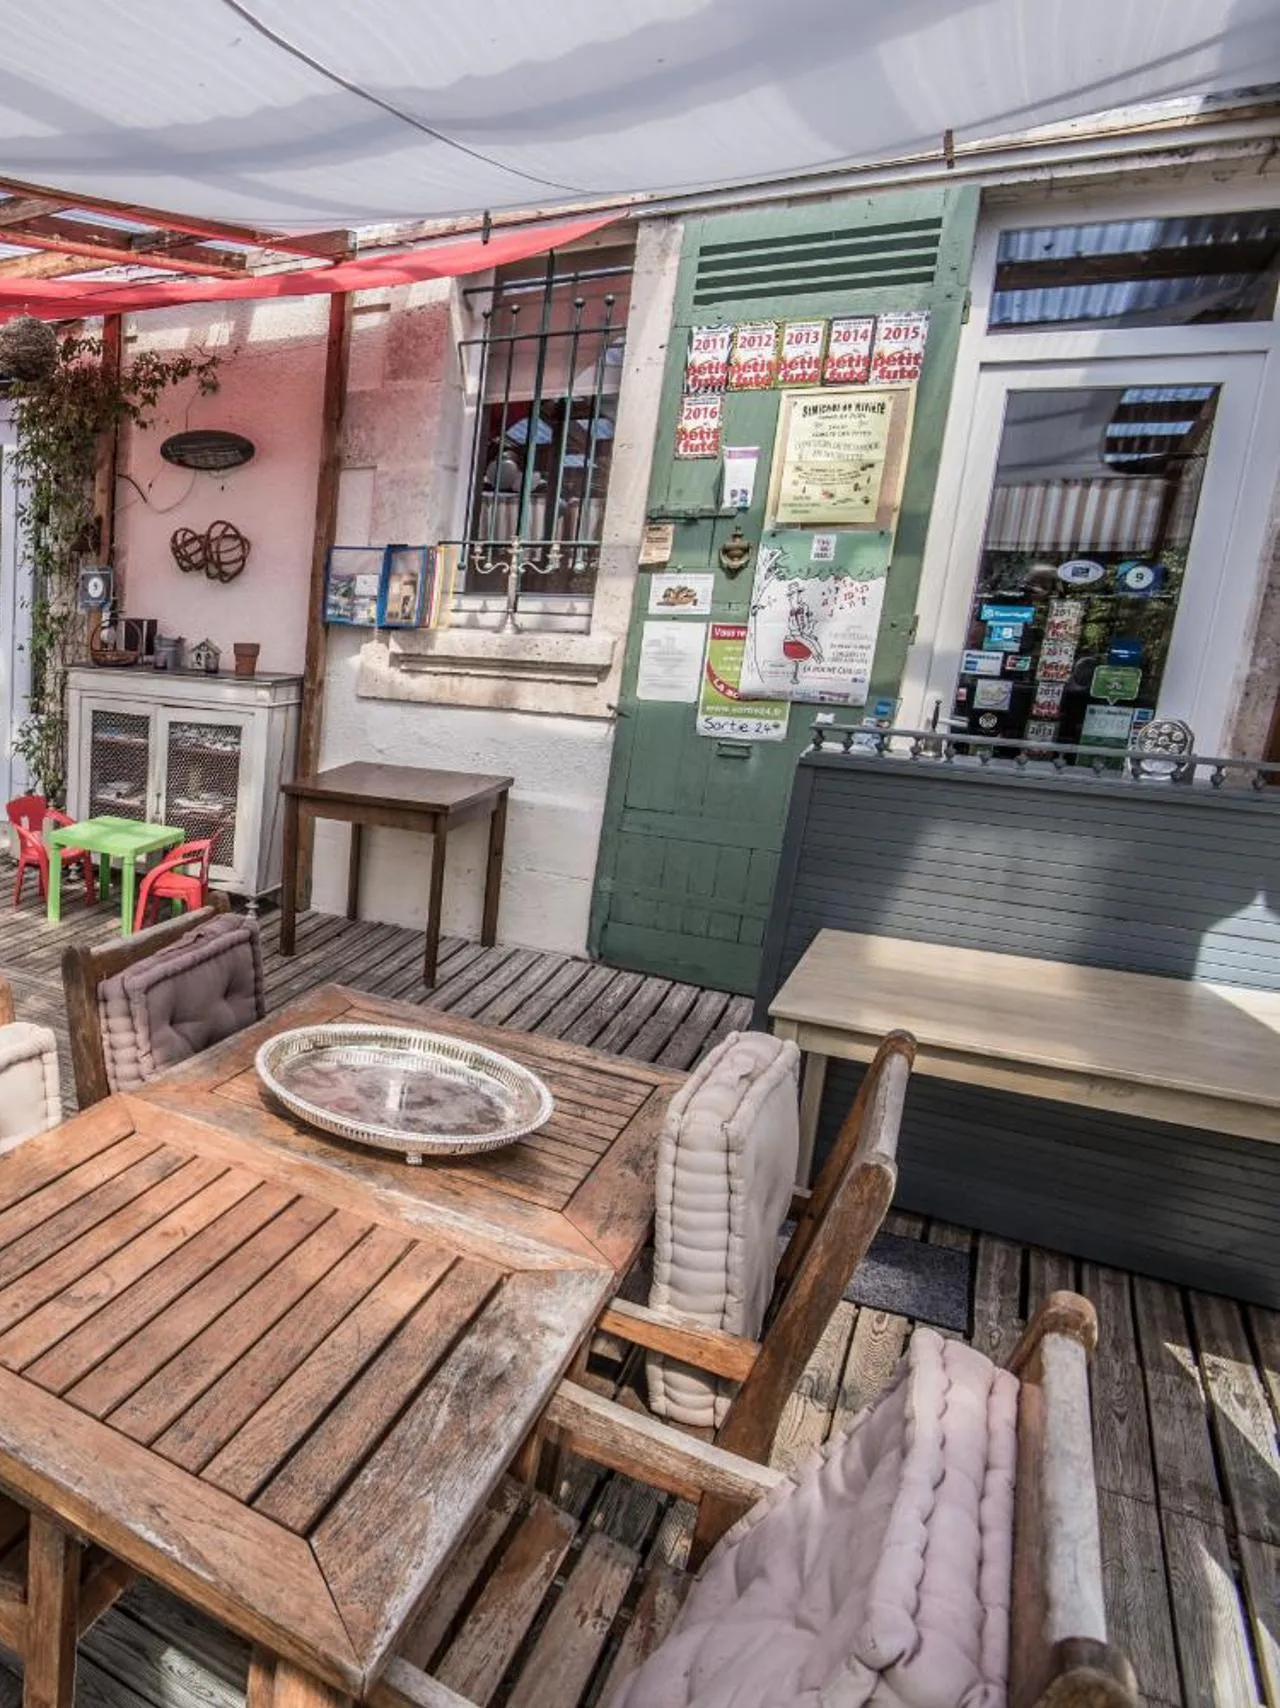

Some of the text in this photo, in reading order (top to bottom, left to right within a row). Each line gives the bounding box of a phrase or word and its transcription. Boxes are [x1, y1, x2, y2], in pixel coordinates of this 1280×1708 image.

[786, 331, 820, 345] 2013
[833, 328, 869, 342] 2014
[883, 326, 920, 340] 2015
[694, 338, 726, 351] 2011
[738, 334, 772, 348] 2012
[687, 359, 728, 376] petit
[729, 358, 776, 375] petit
[778, 355, 821, 373] petit
[825, 352, 870, 369] petit
[873, 351, 923, 370] petit
[683, 407, 718, 421] 2016
[677, 427, 720, 442] petit
